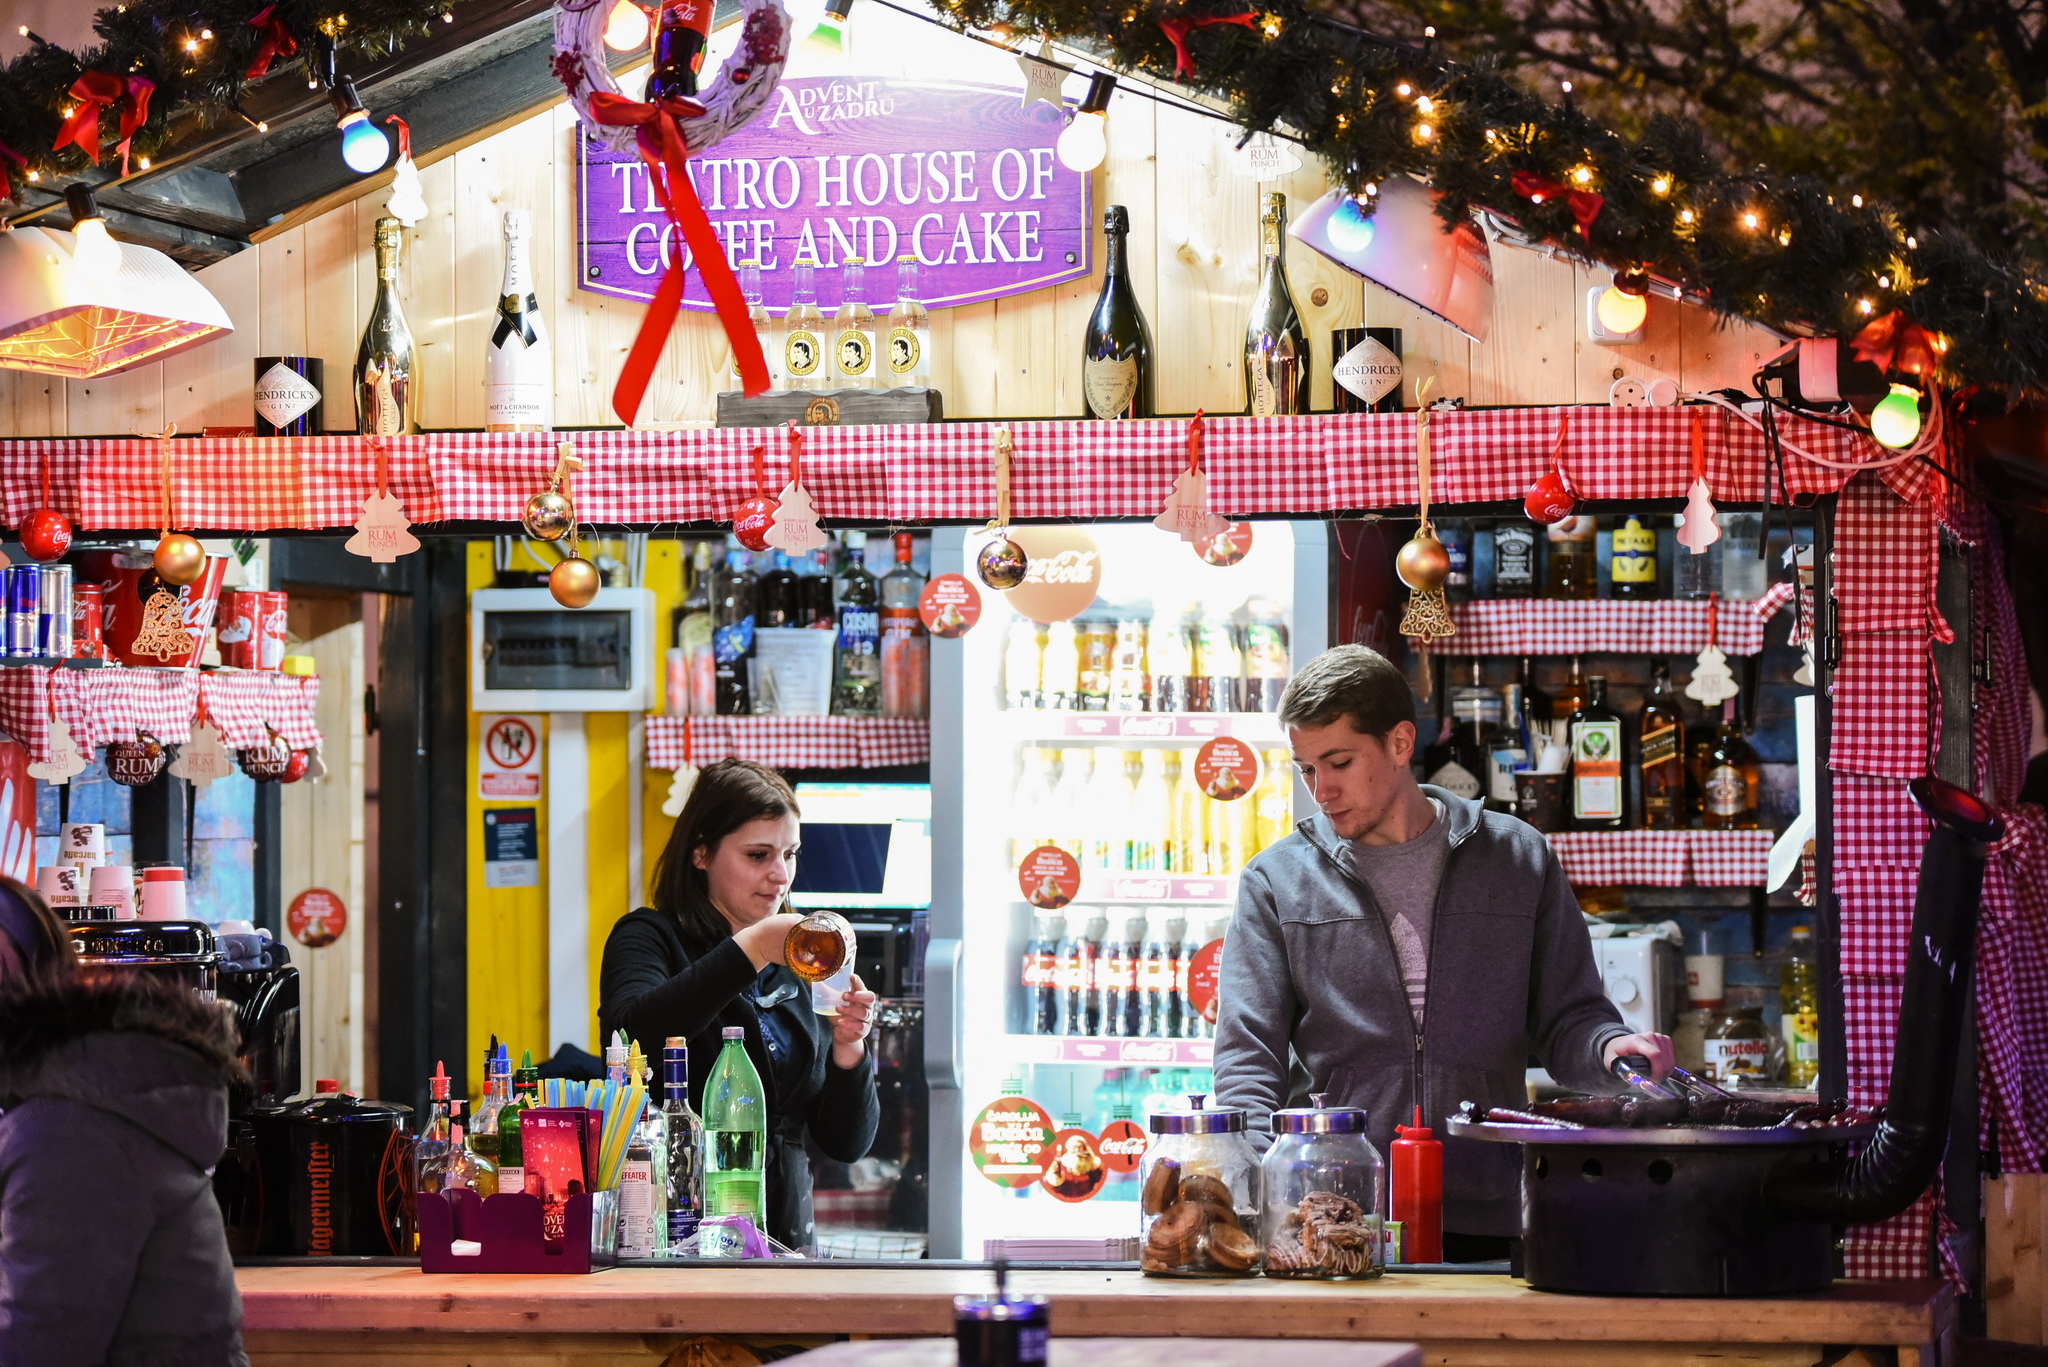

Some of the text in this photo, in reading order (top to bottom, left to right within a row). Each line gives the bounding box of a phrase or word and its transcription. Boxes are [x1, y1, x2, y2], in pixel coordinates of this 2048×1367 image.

[1032, 67, 1057, 81] RUM
[1031, 79, 1057, 89] PUNCH
[767, 80, 879, 135] ADVENT
[818, 98, 894, 121] ZADRU
[1250, 149, 1279, 160] RUM
[815, 150, 979, 207] HOUSE
[992, 147, 1055, 201] OF
[626, 210, 1044, 275] COFEE AND CAKE
[1338, 364, 1401, 376] HENDRICK'S
[1177, 509, 1206, 521] RUM
[784, 522, 808, 534] RUM
[1176, 520, 1207, 529] PUNCH
[368, 529, 397, 541] RUM
[783, 534, 808, 542] PUNCH
[368, 540, 398, 548] PUNCH
[115, 749, 146, 758] QUEEN
[245, 746, 286, 764] RUM
[115, 758, 160, 775] RUM
[188, 757, 214, 767] RUM
[246, 762, 287, 774] PUNCH
[1718, 1040, 1769, 1057] nutella
